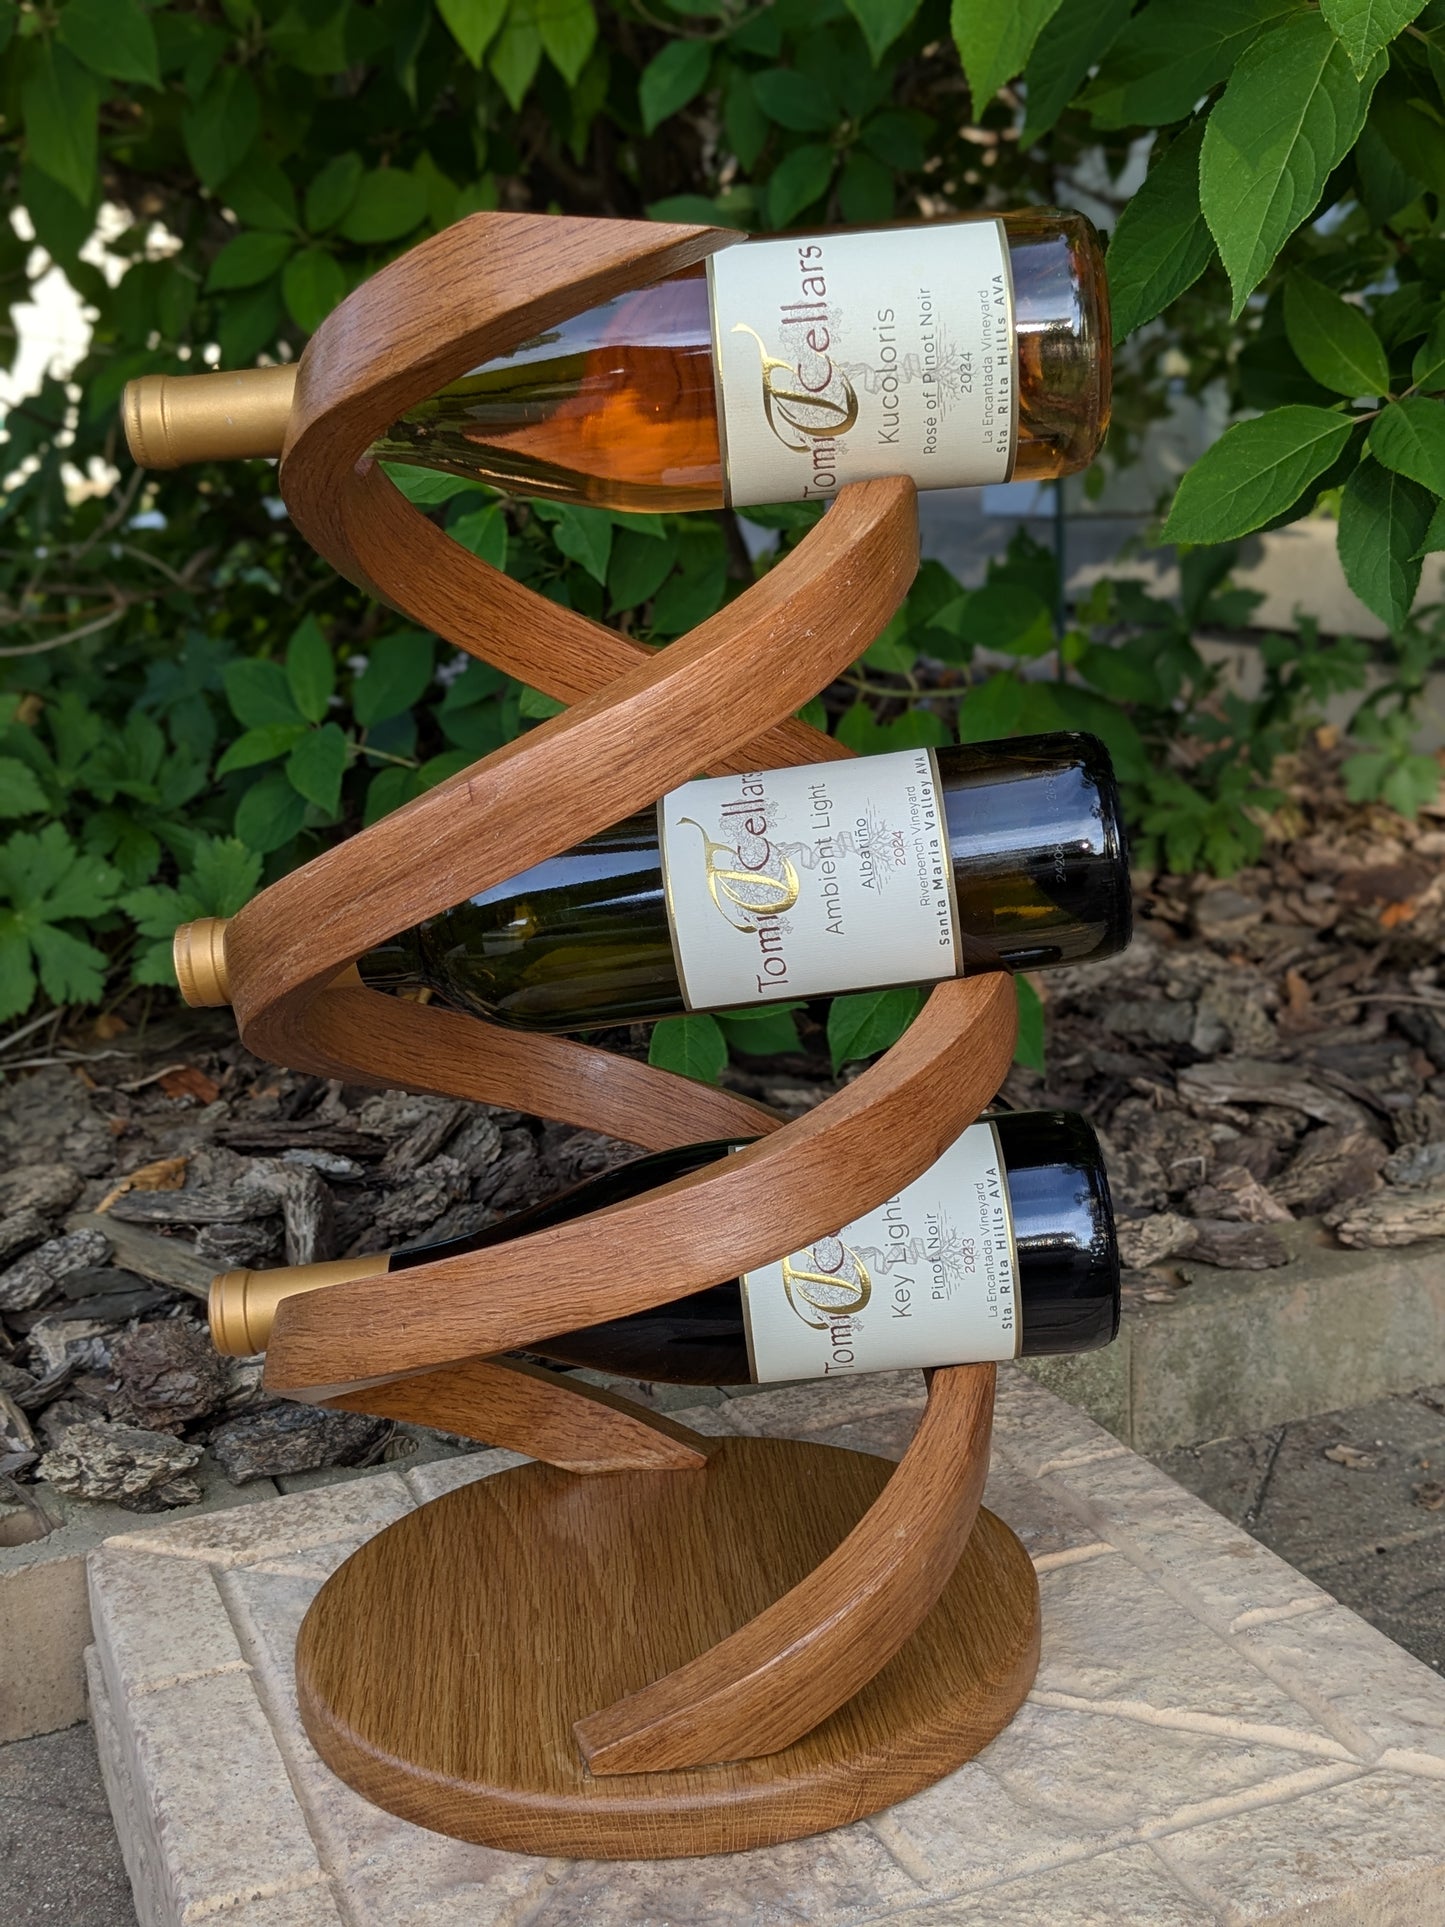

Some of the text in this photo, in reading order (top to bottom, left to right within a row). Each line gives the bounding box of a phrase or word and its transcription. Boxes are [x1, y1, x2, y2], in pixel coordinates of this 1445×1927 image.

[780, 245, 833, 393] Cellars
[872, 307, 899, 445] Kucoloris
[919, 287, 937, 454] Rosé of Pinot Noir
[960, 352, 973, 394] 2024
[977, 289, 994, 444] La Encantada Vineyard
[992, 274, 1009, 453] Sta. Rita Hills AVA
[808, 783, 845, 935] Ambient Light
[854, 817, 875, 889] Albariño
[891, 830, 907, 866] 2024
[905, 785, 931, 907] Riverbench Vineyard
[915, 756, 950, 945] Santa Maria Valley AVA
[882, 1197, 915, 1318] Key Light
[924, 1212, 946, 1300] Pinot Noir
[964, 1238, 976, 1273] 2023
[973, 1182, 998, 1318] La Encantada Vineyard
[988, 1167, 1013, 1330] Sta. Rita Hills AVA
